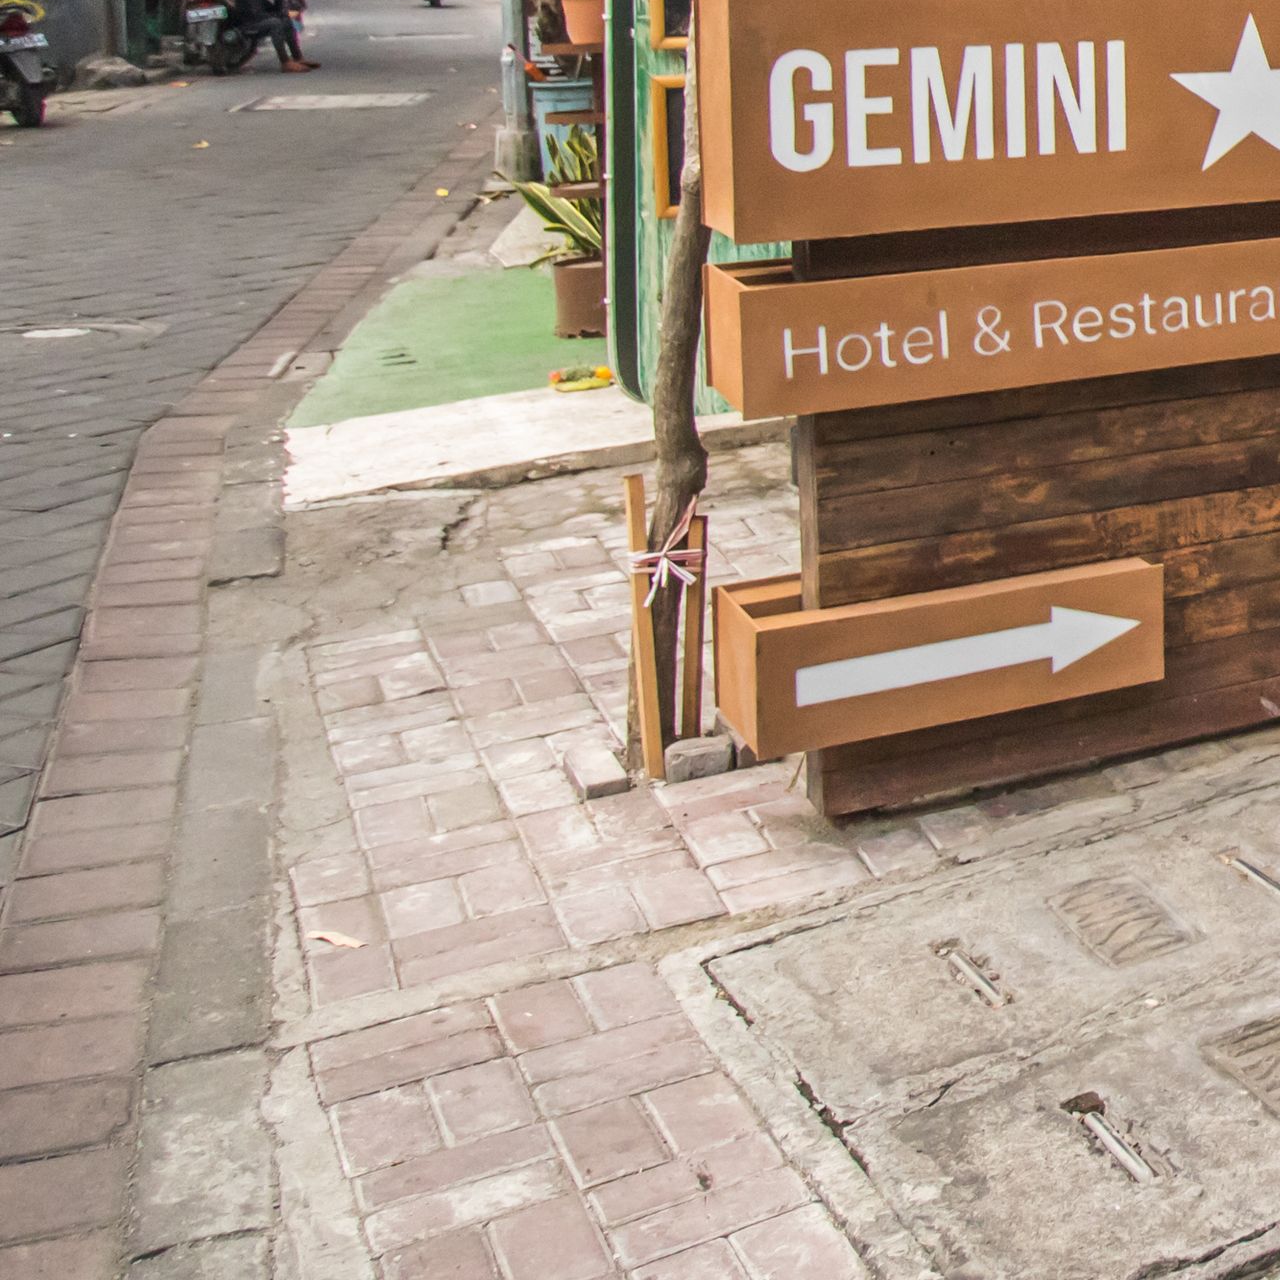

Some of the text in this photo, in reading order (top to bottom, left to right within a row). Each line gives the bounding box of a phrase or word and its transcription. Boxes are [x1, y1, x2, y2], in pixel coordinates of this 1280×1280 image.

[768, 38, 1127, 173] GEMINI
[782, 308, 949, 380] Hotel
[972, 306, 1012, 359] &
